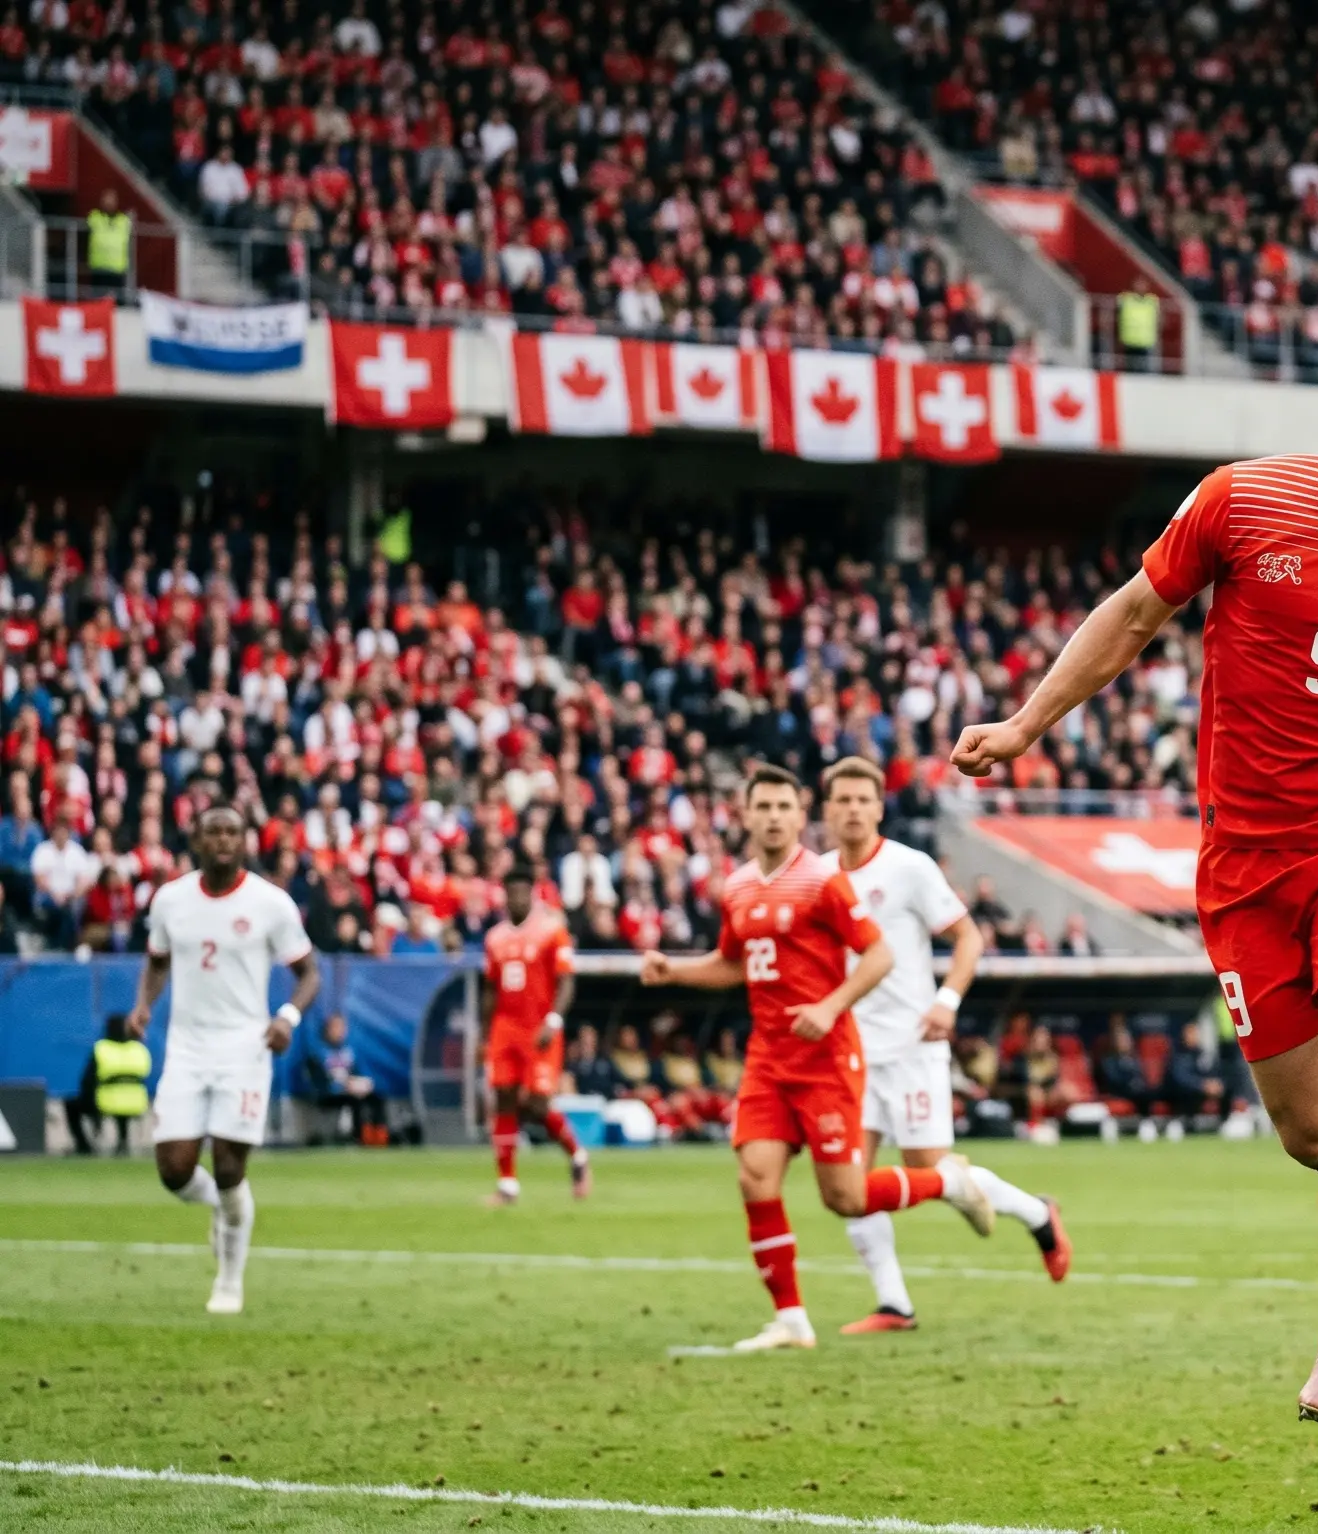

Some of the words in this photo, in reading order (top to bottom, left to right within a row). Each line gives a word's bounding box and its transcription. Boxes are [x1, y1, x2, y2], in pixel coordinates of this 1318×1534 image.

[200, 938, 217, 971] 2
[744, 936, 781, 983] 22
[1219, 971, 1253, 1037] 9
[904, 1089, 931, 1124] 19
